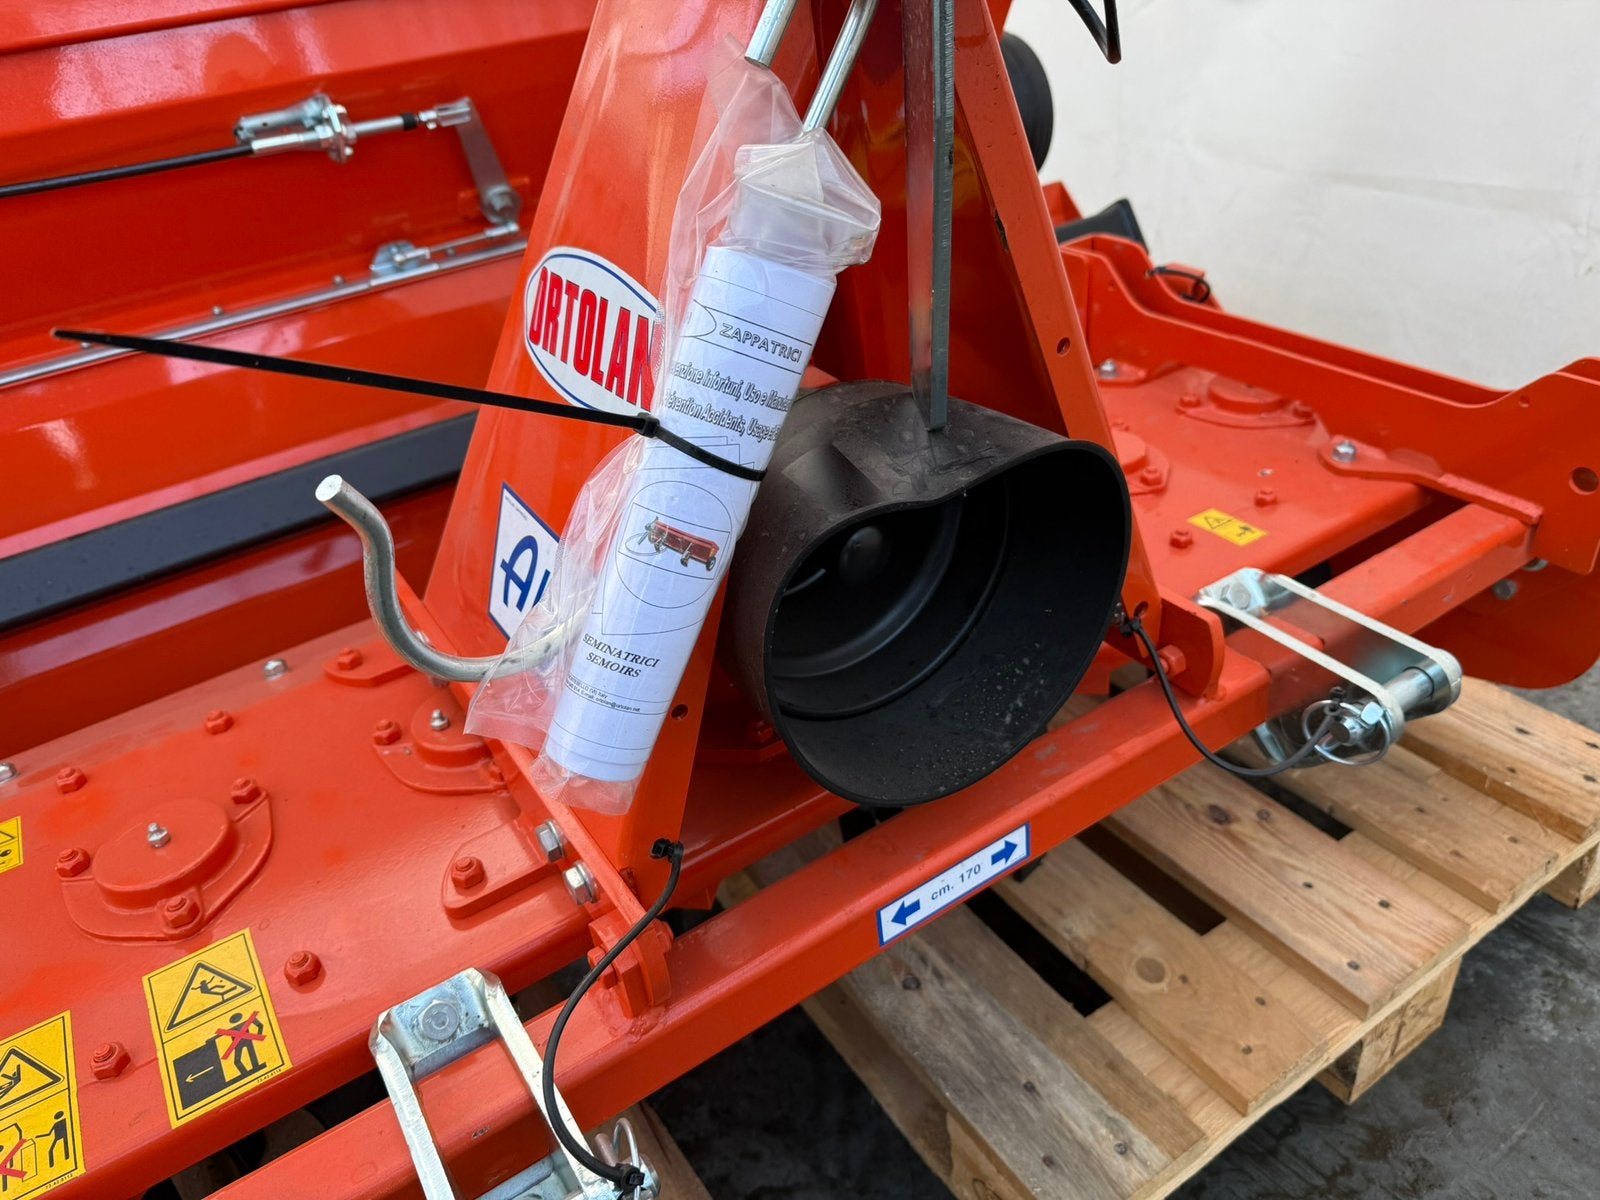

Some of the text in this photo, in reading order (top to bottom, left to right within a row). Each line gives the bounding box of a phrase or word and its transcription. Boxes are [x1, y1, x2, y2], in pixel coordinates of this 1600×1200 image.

[529, 266, 663, 412] ORTOLAN
[719, 323, 802, 363] ZAPPATRICI
[702, 368, 744, 401] Infortuni,
[743, 382, 761, 404] Uso
[760, 392, 767, 405] e
[700, 403, 746, 436] Accidents,
[747, 417, 771, 443] Usage
[582, 633, 660, 668] SEMINATRICI
[586, 652, 642, 678] SEMOIRS
[931, 863, 982, 901] cm. 170
